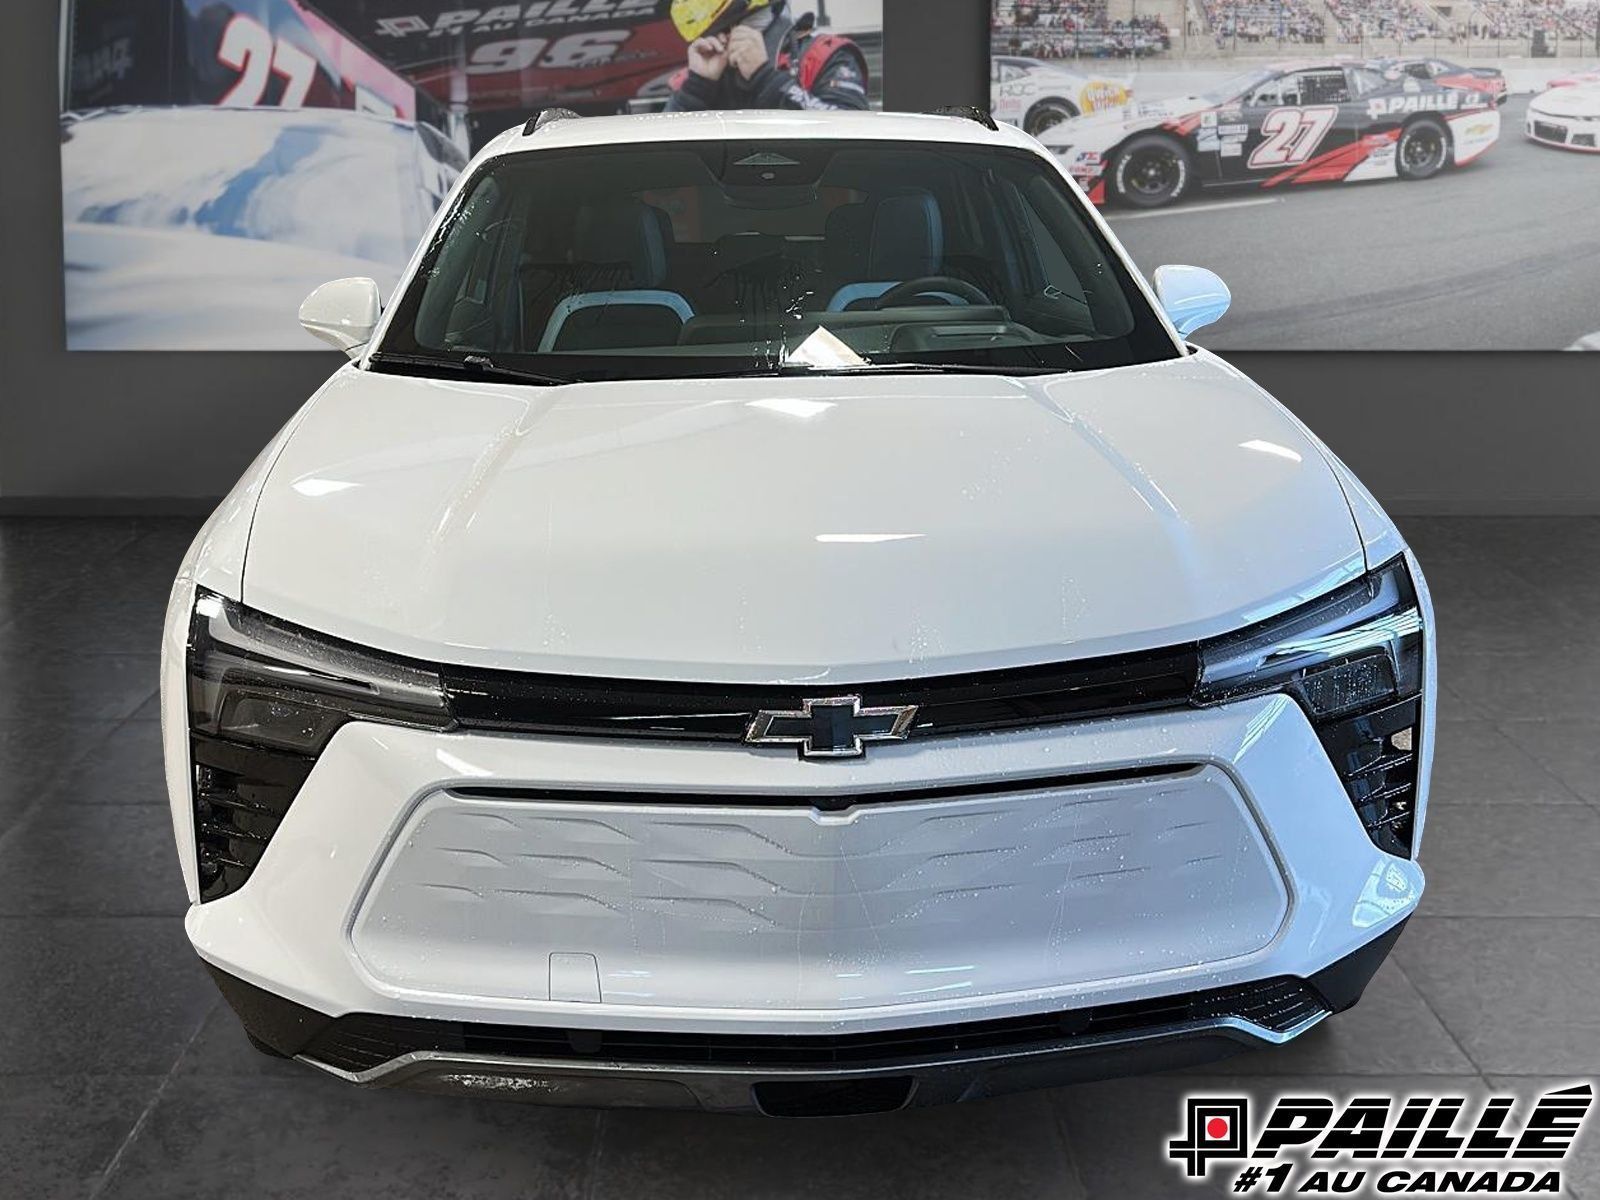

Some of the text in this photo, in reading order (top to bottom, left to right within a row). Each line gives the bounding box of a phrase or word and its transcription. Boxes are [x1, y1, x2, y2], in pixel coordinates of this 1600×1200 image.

[472, 21, 517, 33] AU
[524, 7, 655, 27] CANADA
[217, 12, 317, 108] 27
[464, 29, 633, 74] 96
[1247, 104, 1339, 169] 27
